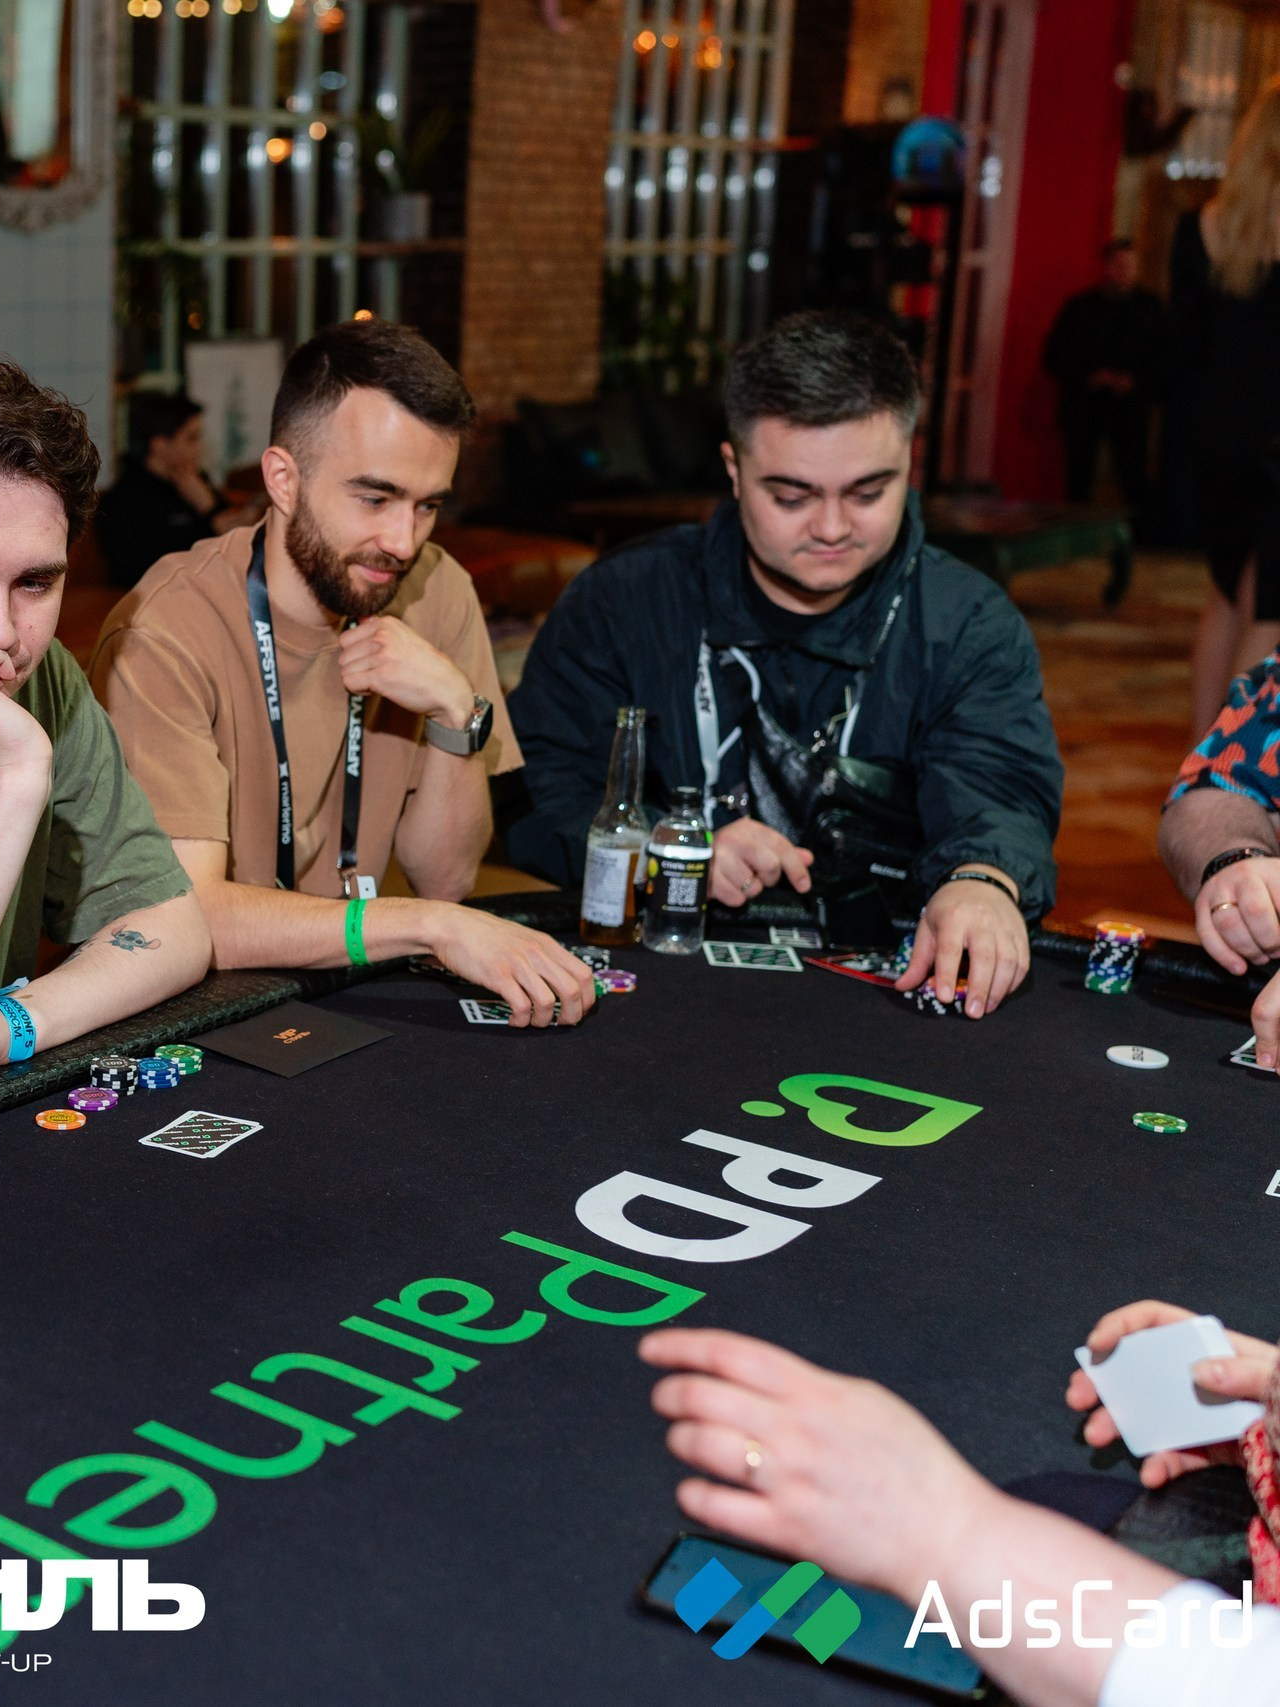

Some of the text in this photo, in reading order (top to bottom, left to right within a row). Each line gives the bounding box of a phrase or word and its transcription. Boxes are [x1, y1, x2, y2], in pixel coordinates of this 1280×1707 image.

[255, 620, 281, 722] AFFSTYLE
[347, 694, 364, 777] AFFSTYL
[24, 1040, 33, 1048] 5
